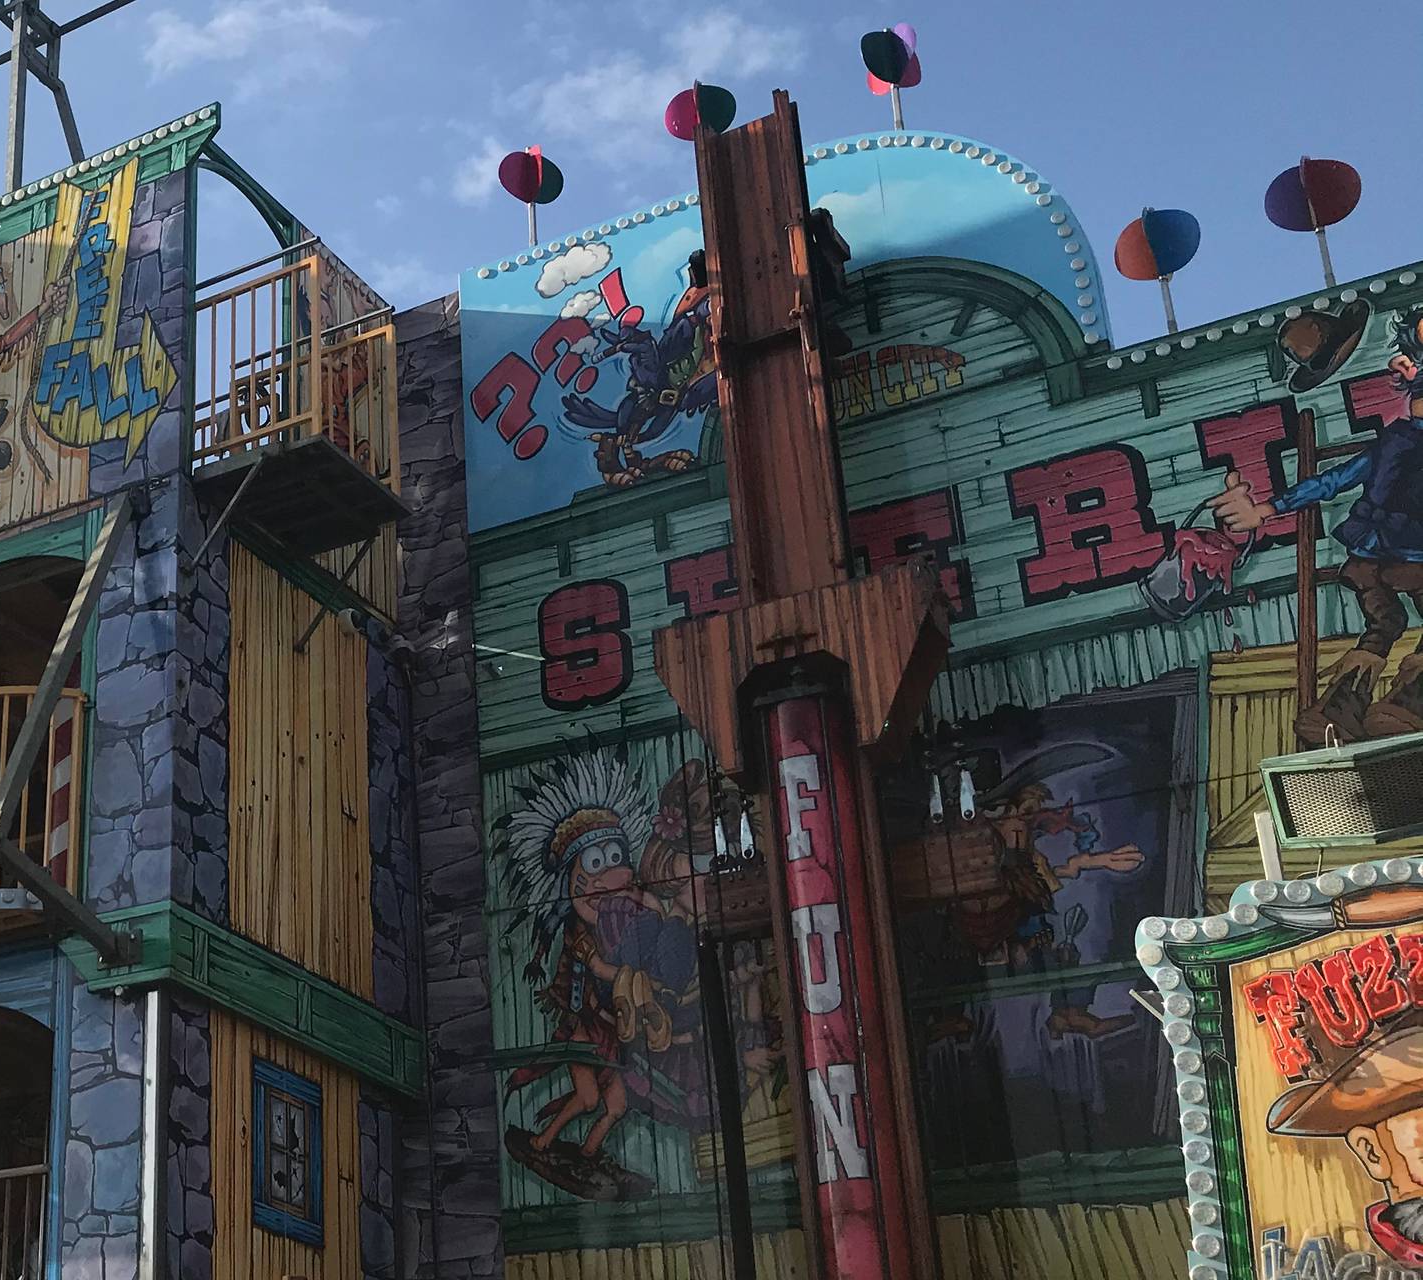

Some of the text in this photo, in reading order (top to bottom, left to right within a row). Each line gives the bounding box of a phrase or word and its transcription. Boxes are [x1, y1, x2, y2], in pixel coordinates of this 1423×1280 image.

[35, 338, 160, 426] FALL
[876, 343, 966, 407] CITY
[779, 753, 870, 1184] FUN
